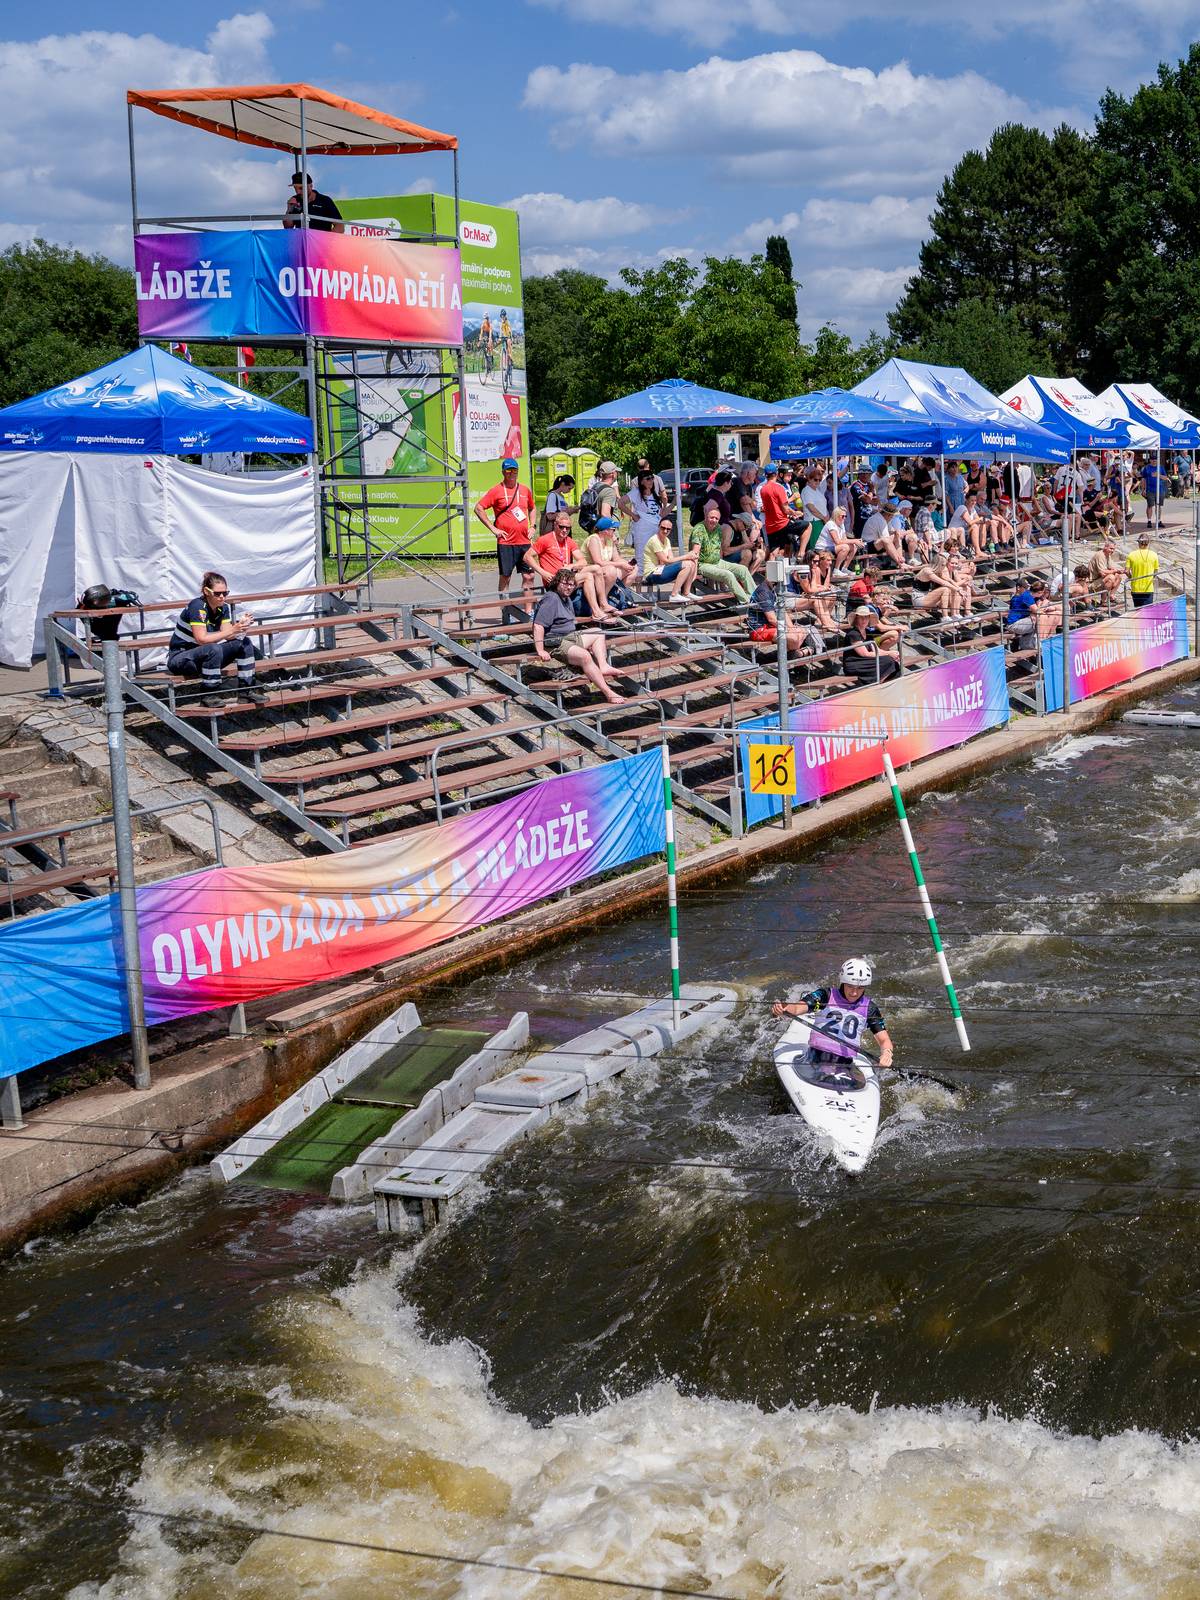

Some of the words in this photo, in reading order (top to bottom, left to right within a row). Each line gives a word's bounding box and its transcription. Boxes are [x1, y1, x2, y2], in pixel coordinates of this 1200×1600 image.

[351, 225, 391, 237] Dr.Max
[463, 226, 491, 243] Dr.Max
[484, 266, 511, 279] podpora
[278, 265, 401, 305] OLYMPIÁDA
[404, 272, 446, 309] DĚTÍ
[450, 283, 463, 311] A
[469, 411, 500, 421] COLLAGEN
[470, 421, 488, 431] 2000
[371, 491, 399, 500] naplno.
[1074, 638, 1119, 677] OLYMPIÁDA
[1144, 616, 1174, 649] MLÁDEŽE
[805, 710, 889, 769] OLYMPIÁDA
[892, 694, 920, 737] DĚTÍ
[922, 702, 932, 727] A
[934, 675, 984, 724] MLÁDEŽE
[756, 752, 788, 786] 16
[152, 893, 364, 987] OLYMPIÁDA
[374, 861, 441, 927] DĚTÍ
[449, 866, 467, 899] A
[475, 803, 594, 887] MLÁDEŽE
[823, 1010, 860, 1040] 20
